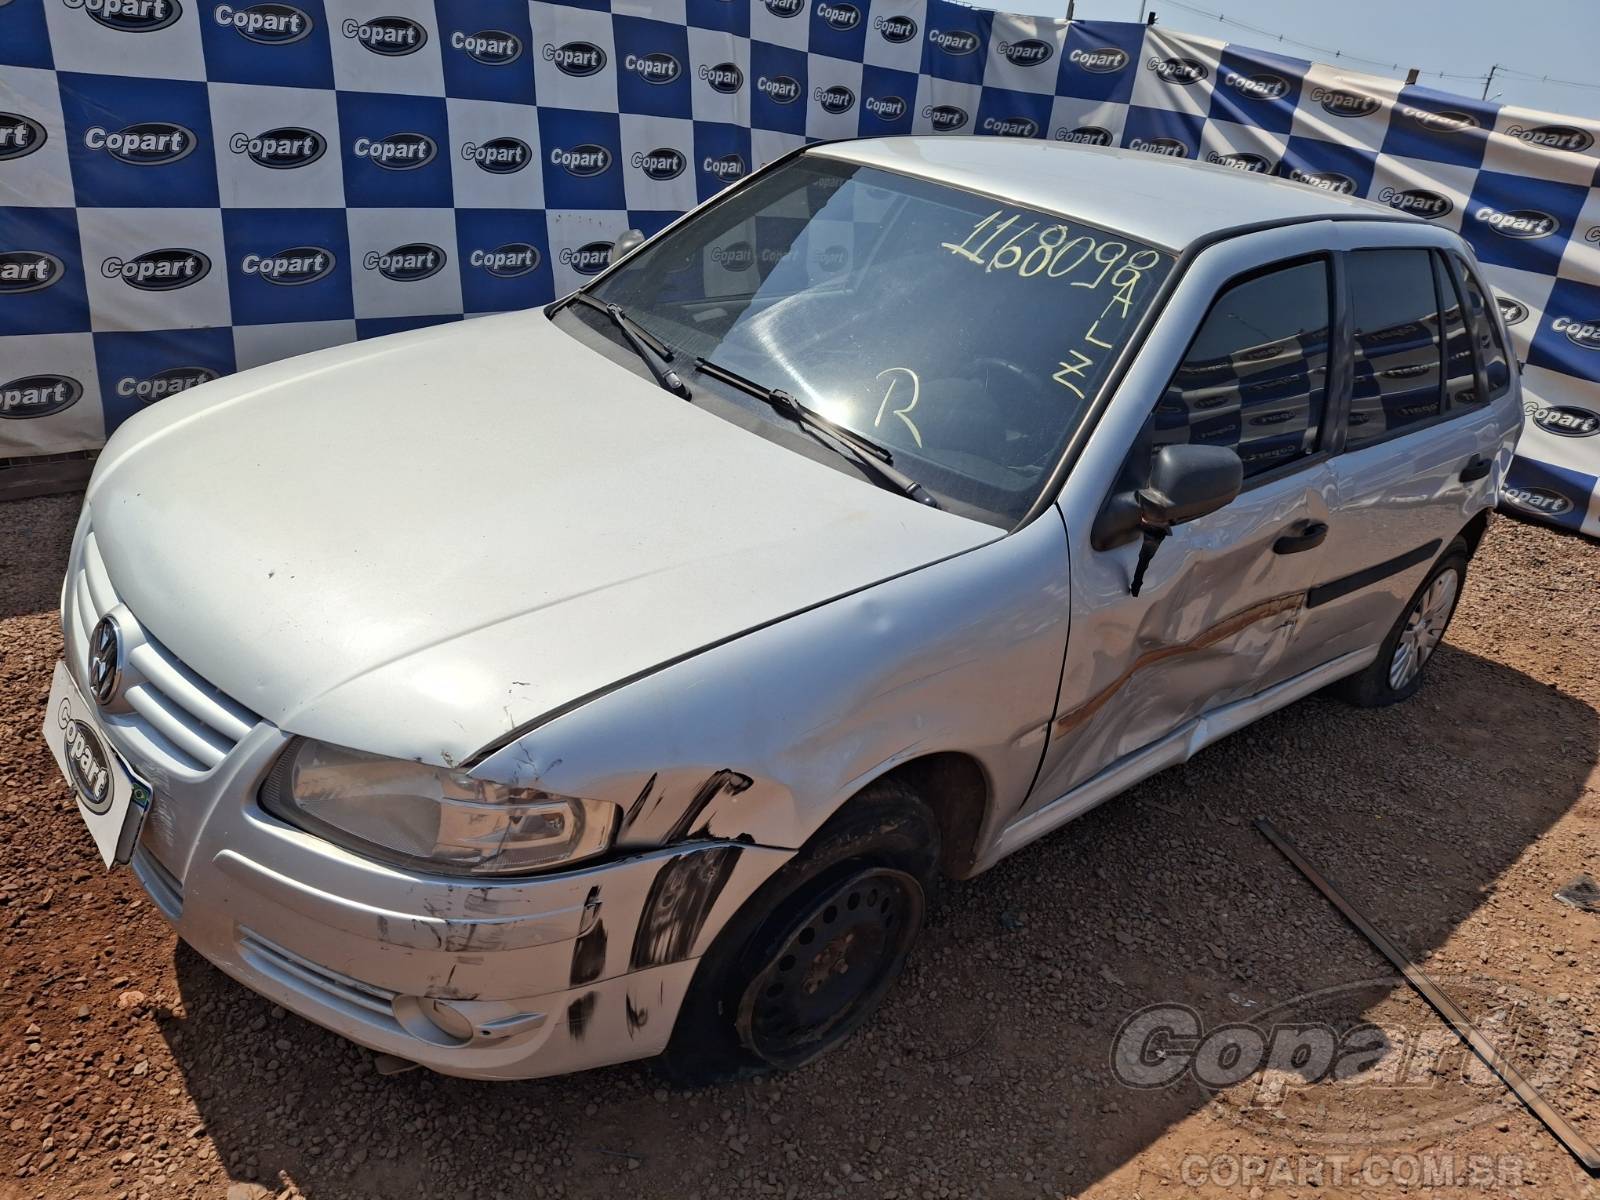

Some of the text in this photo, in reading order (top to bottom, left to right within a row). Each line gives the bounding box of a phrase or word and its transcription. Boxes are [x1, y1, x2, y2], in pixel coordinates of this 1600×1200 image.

[214, 5, 300, 33] Copart
[817, 3, 857, 25] Copart
[342, 19, 416, 44] Copart
[874, 16, 912, 36] Copart
[451, 32, 514, 55] Copart
[929, 29, 973, 50] Copart
[998, 41, 1045, 59] Copart
[543, 44, 598, 66] Copart
[625, 55, 674, 76] Copart
[1069, 49, 1122, 68] Copart
[1147, 57, 1200, 80] Copart
[757, 77, 797, 97] Copart
[814, 86, 850, 105] Copart
[1225, 72, 1283, 97] Copart
[865, 97, 902, 114] Copart
[1310, 87, 1373, 110] Copart
[922, 105, 960, 124] Cpart
[983, 118, 1031, 136] Copart
[1055, 127, 1103, 145] Copart
[1505, 125, 1581, 148] Copart
[84, 127, 183, 153] Copart
[229, 133, 313, 157] Copart
[354, 138, 426, 158] Copart
[1129, 139, 1182, 157] Copart
[461, 142, 522, 161] Copart
[551, 148, 603, 167] Copart
[631, 152, 678, 170] Copart
[1378, 187, 1443, 212] Copart
[1475, 207, 1549, 234] Copart
[101, 256, 196, 278] Copart
[242, 253, 323, 276] Copart
[364, 249, 435, 271] Copart
[470, 248, 532, 270] Copart
[874, 366, 922, 448] R
[1523, 401, 1595, 432] Copart
[57, 697, 108, 799] Copart
